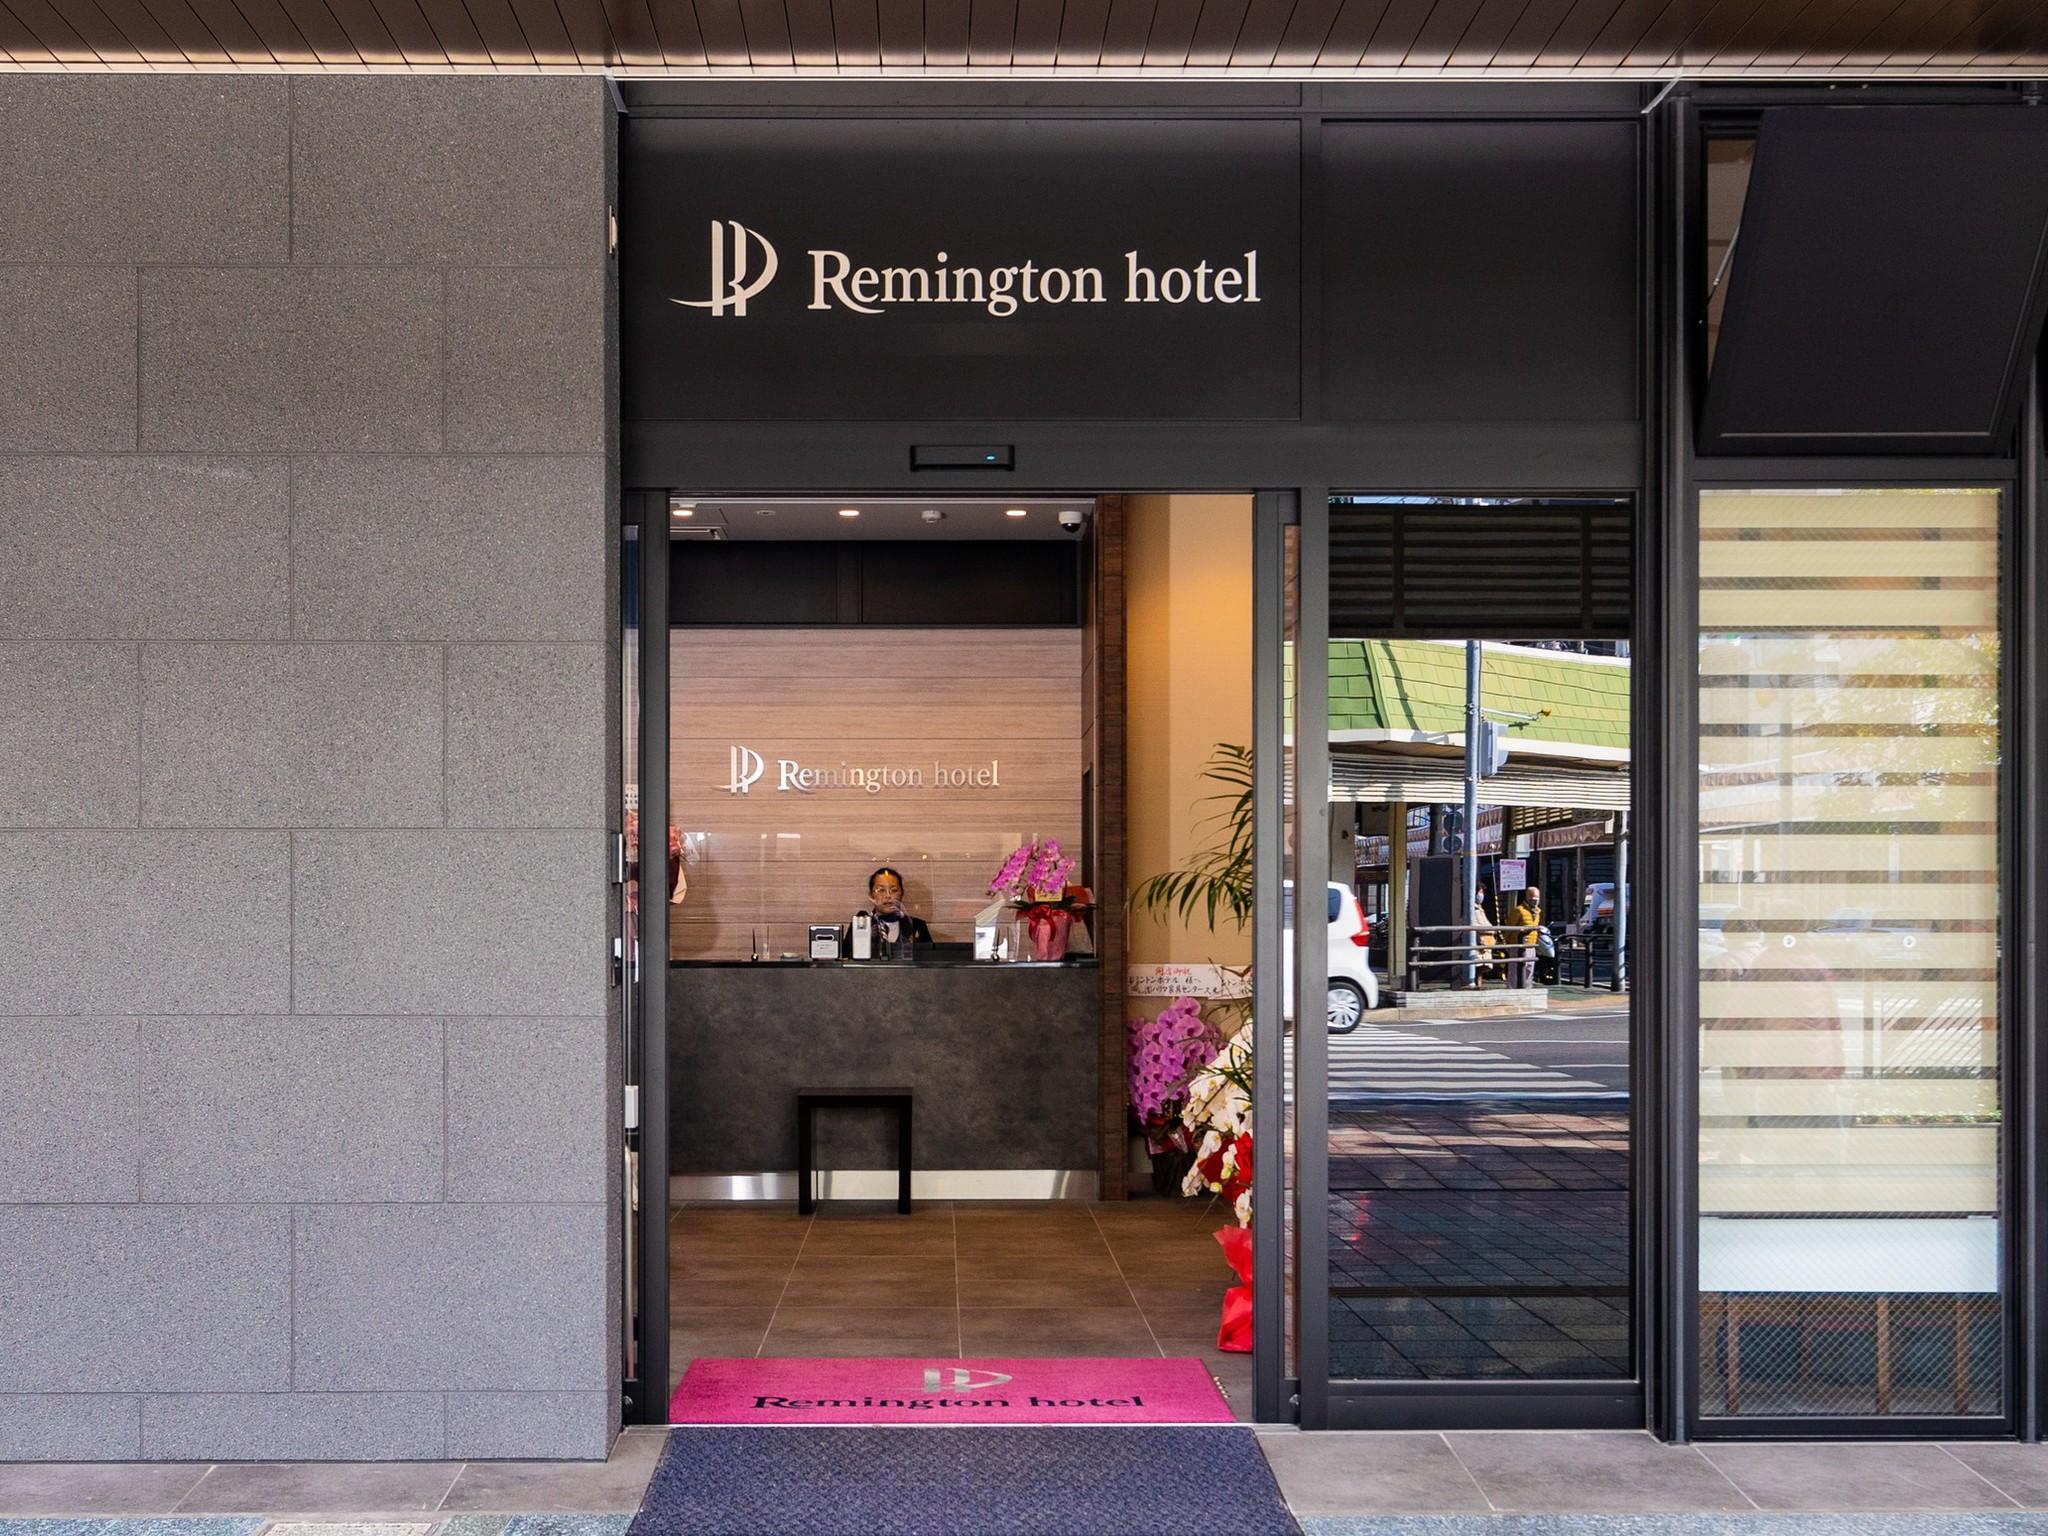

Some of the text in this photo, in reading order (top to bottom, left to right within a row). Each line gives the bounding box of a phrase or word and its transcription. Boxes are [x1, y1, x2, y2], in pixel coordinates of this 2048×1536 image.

[807, 249, 1262, 317] Remington hotel
[777, 759, 1000, 793] Remington hotel
[750, 1395, 1145, 1410] Remington hotel
